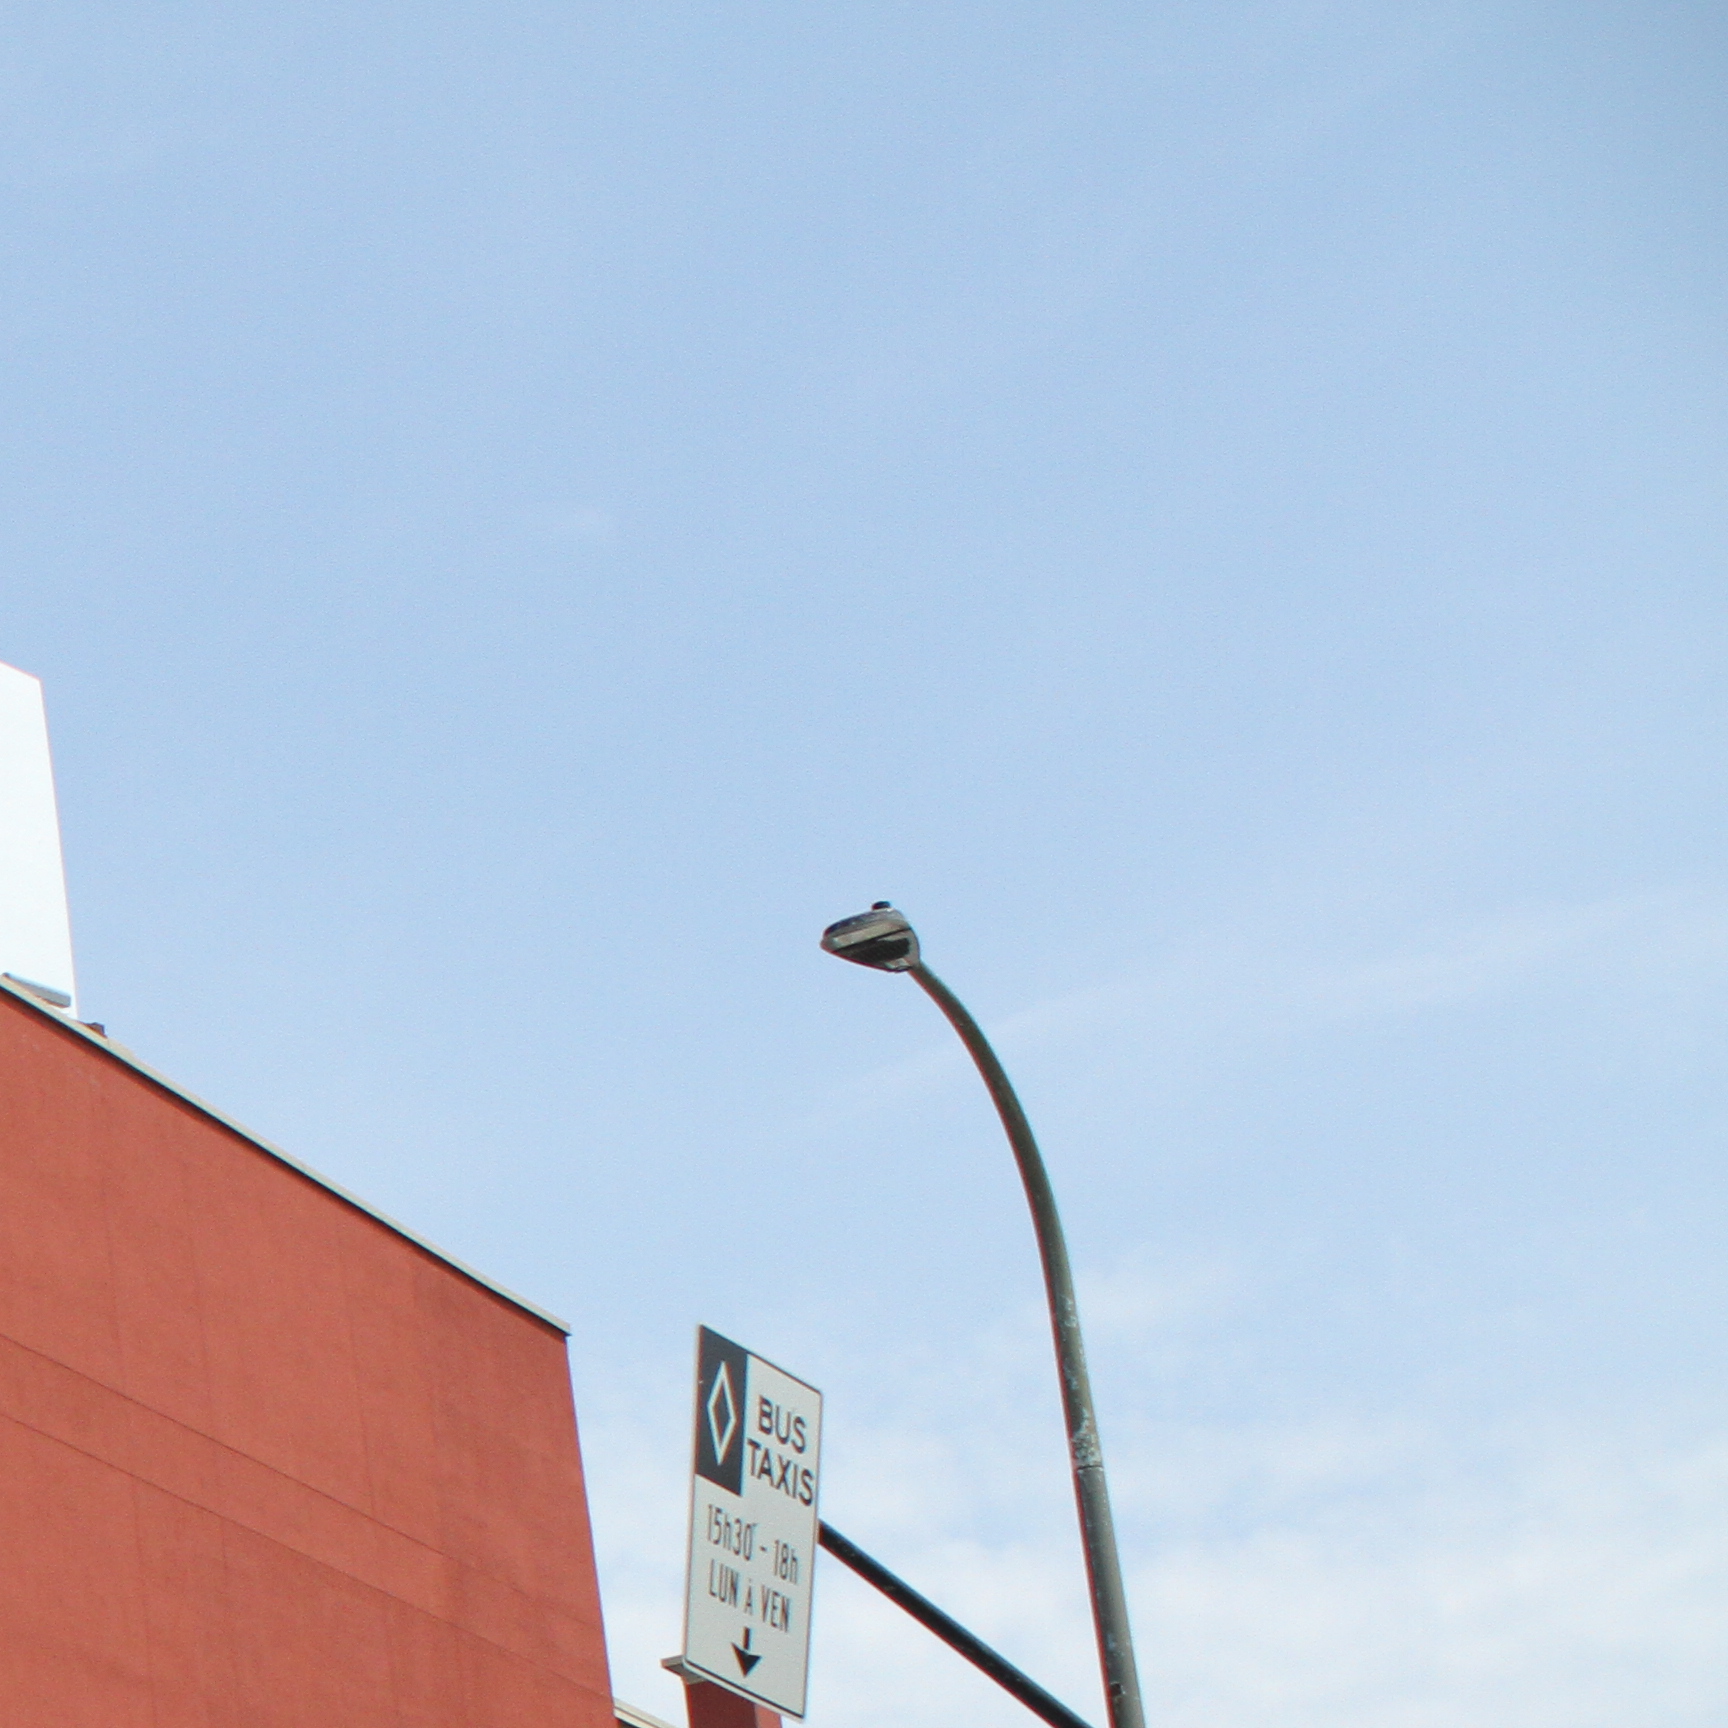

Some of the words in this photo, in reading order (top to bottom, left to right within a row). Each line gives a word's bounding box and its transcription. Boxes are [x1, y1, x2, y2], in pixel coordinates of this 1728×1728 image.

[758, 1393, 807, 1454] BUS
[747, 1437, 814, 1507] TAXIS
[707, 1503, 754, 1562] 15h30
[774, 1539, 799, 1585] 18h
[708, 1558, 740, 1609] LUN
[760, 1584, 791, 1633] VEN
